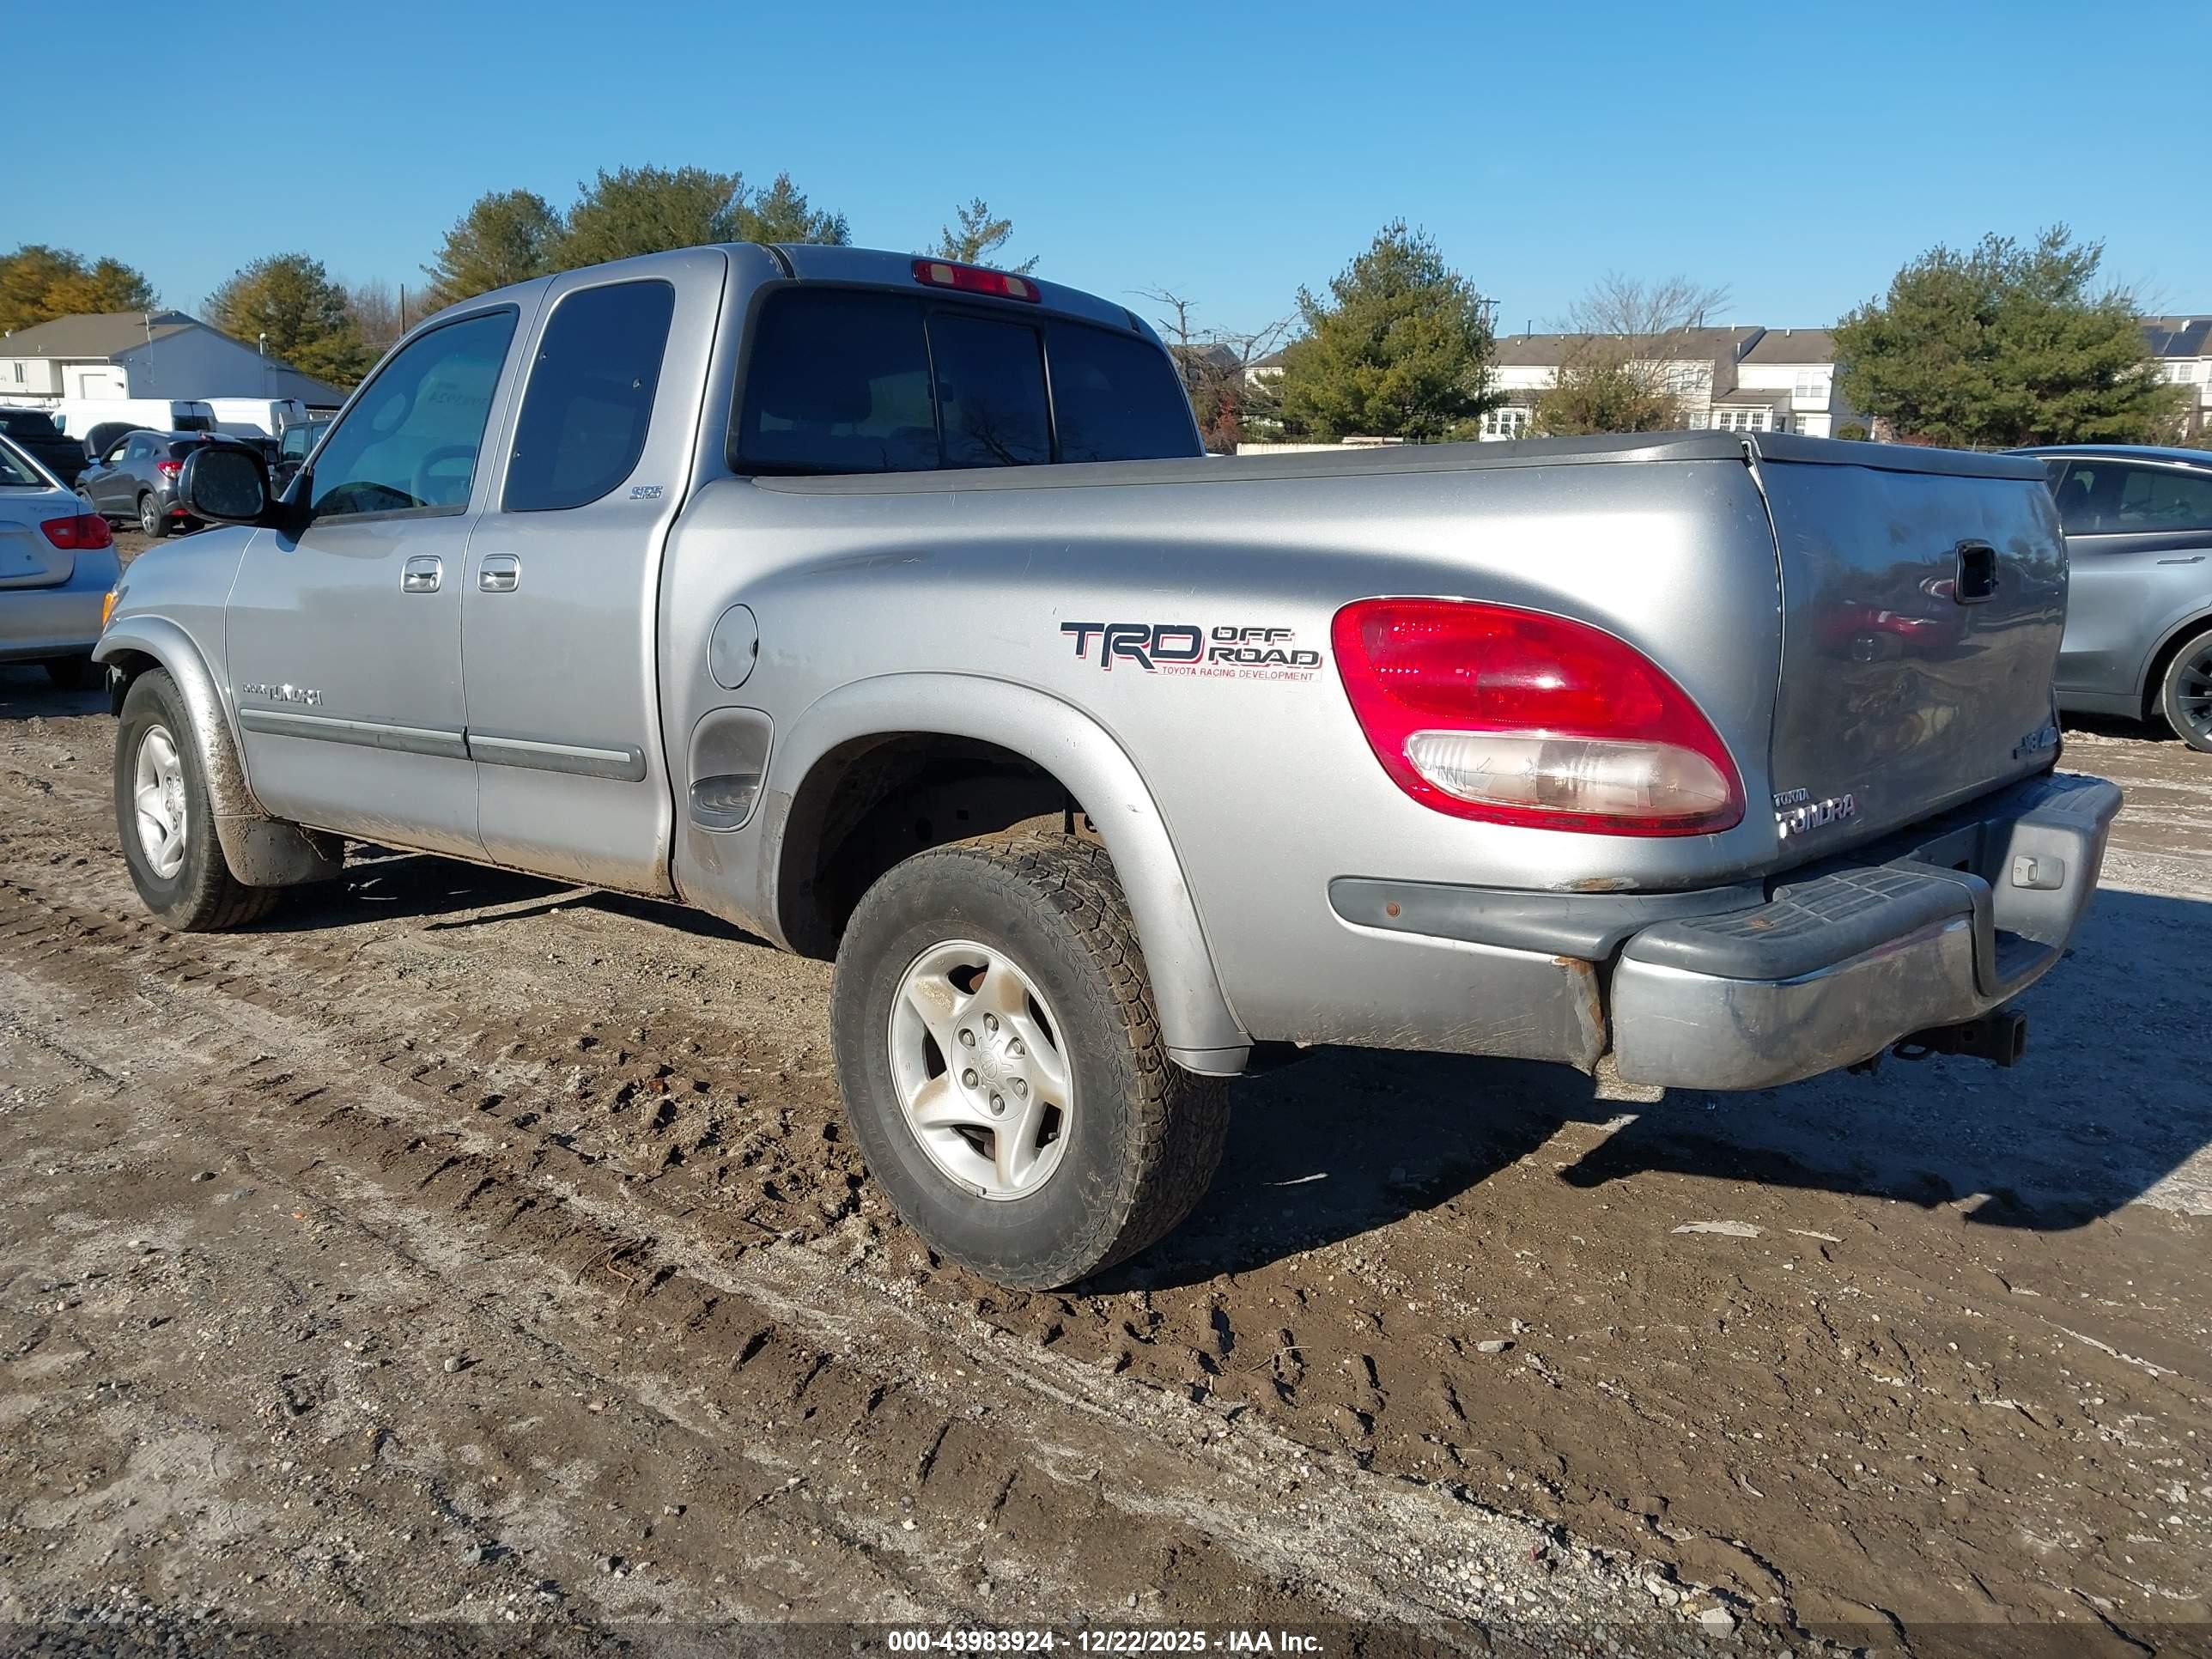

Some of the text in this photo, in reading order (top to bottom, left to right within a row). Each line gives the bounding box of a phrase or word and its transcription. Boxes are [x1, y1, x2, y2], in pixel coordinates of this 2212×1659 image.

[1211, 626, 1294, 645] OFF
[1060, 622, 1205, 672] TRD
[1208, 647, 1322, 669] ROAD
[1163, 665, 1314, 681] TOYOTA RACING DEVELOPMENT
[1773, 787, 1809, 807] TOYOTA
[1775, 793, 1856, 839] TUNDRA
